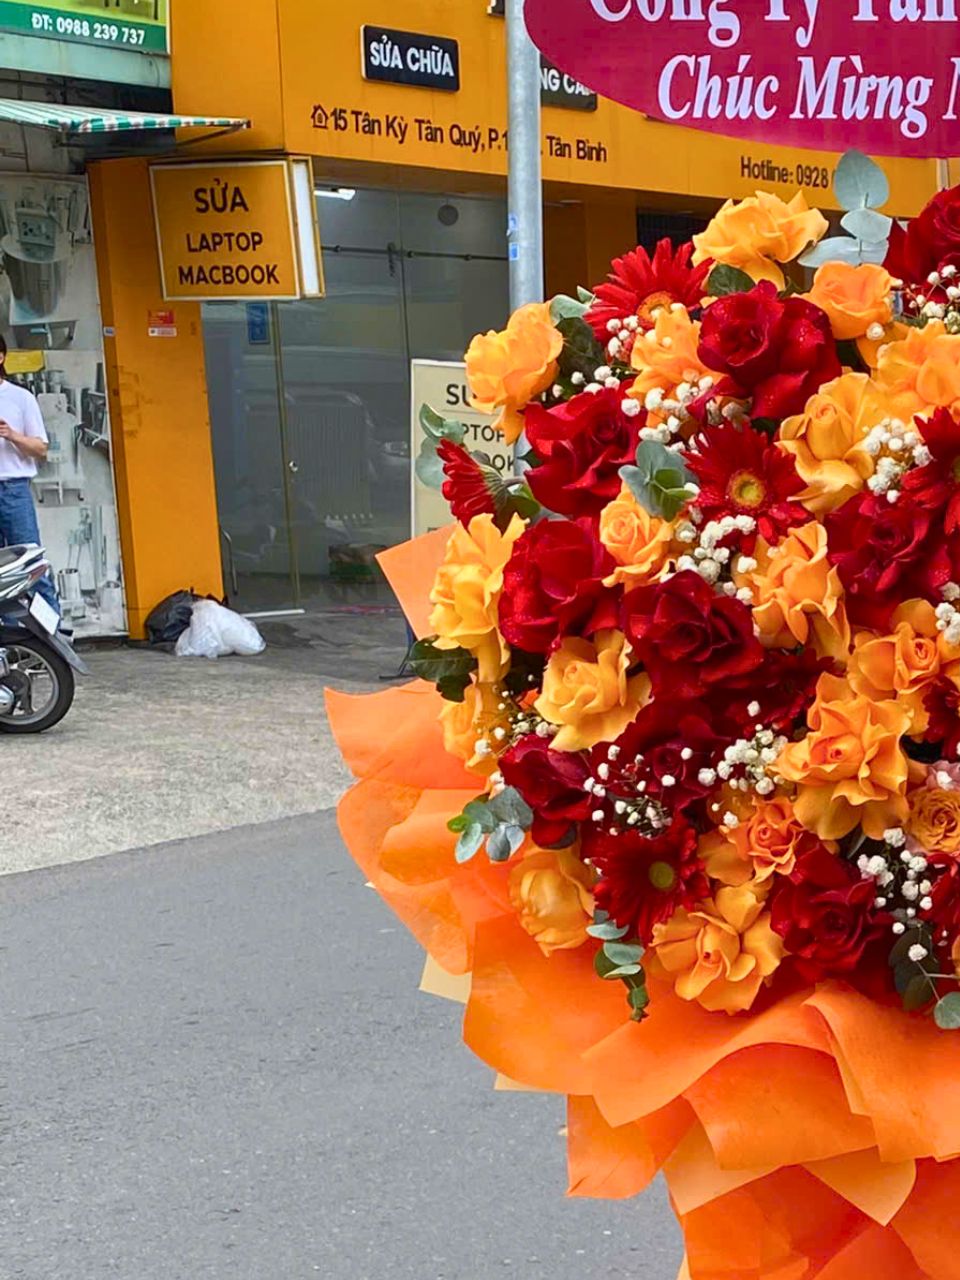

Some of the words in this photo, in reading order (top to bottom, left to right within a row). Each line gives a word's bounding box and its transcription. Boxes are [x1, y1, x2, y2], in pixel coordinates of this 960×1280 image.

[31, 13, 53, 31] ĐT:
[56, 16, 91, 37] 0988
[93, 24, 118, 41] 239
[122, 27, 145, 45] 737
[370, 35, 403, 70] SỬA
[406, 45, 454, 77] CHỮA
[657, 54, 780, 120] Chúc
[789, 55, 934, 139] Mừng
[330, 108, 348, 131] 15
[351, 110, 382, 136] Tân
[386, 115, 408, 144] Kỳ
[415, 119, 444, 144] Tân
[450, 124, 486, 152] Quý,
[546, 134, 572, 159] Tân
[576, 138, 607, 163] Bình
[741, 156, 794, 185] Hotline:
[796, 163, 829, 189] 0928
[194, 178, 249, 213] SỬA
[186, 232, 263, 252] LAPTOP
[178, 264, 280, 285] MACBOOK
